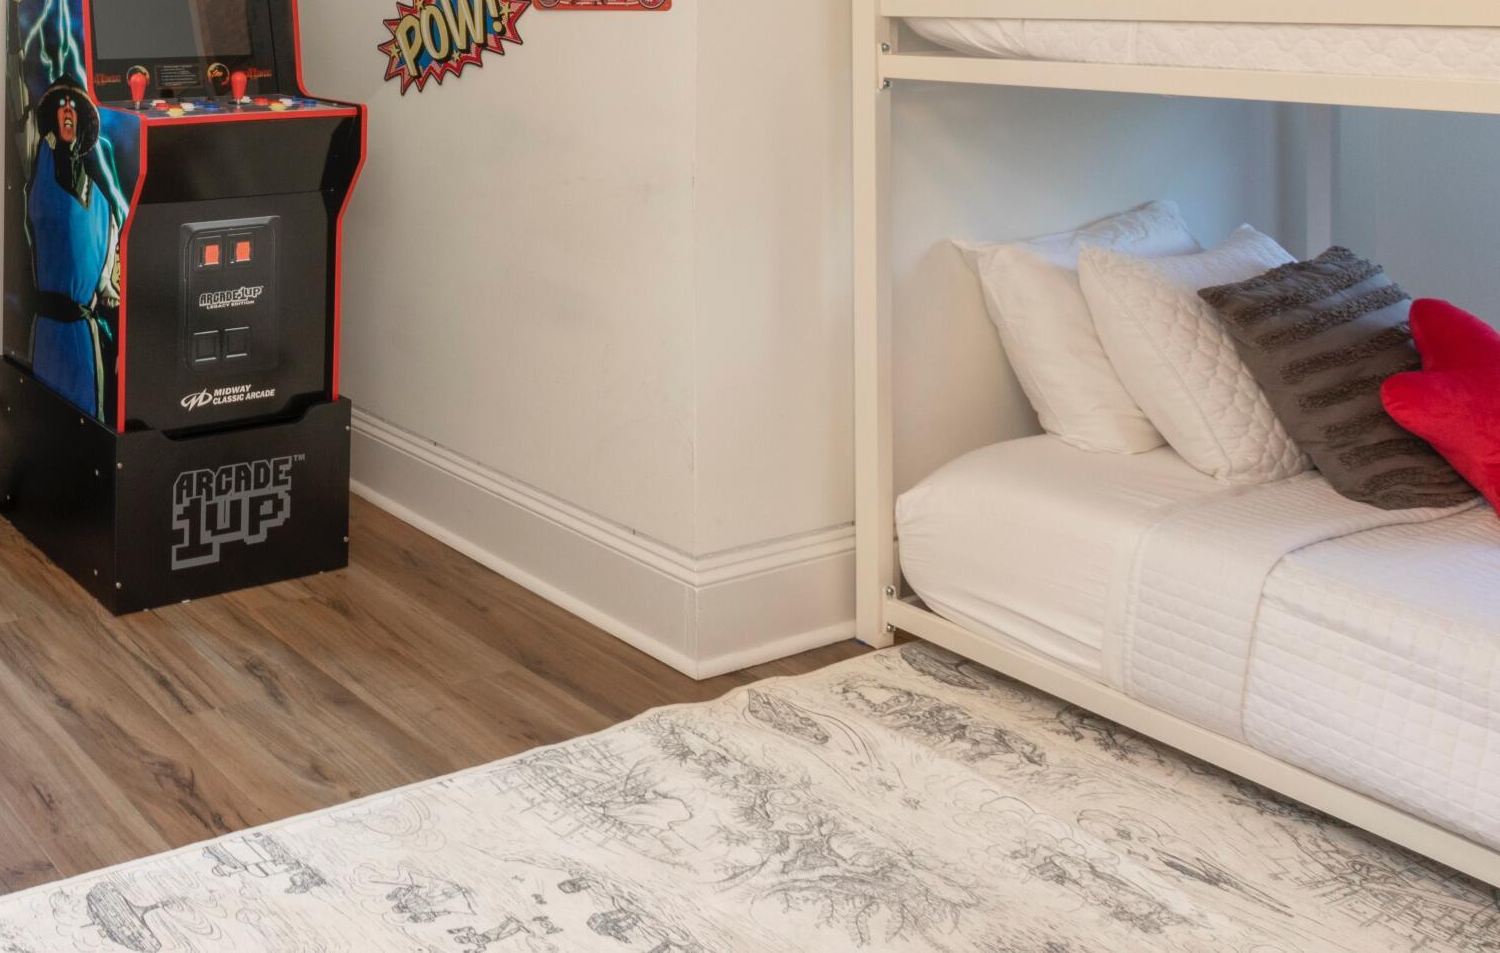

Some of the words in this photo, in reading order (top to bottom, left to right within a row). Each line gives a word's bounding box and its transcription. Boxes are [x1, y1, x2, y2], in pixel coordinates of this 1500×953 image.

[213, 384, 252, 397] MIDWAY
[213, 394, 244, 406] CLASSIC
[245, 388, 275, 401] ARCADE
[174, 456, 292, 506] ARCADE
[171, 493, 291, 570] 1UP
